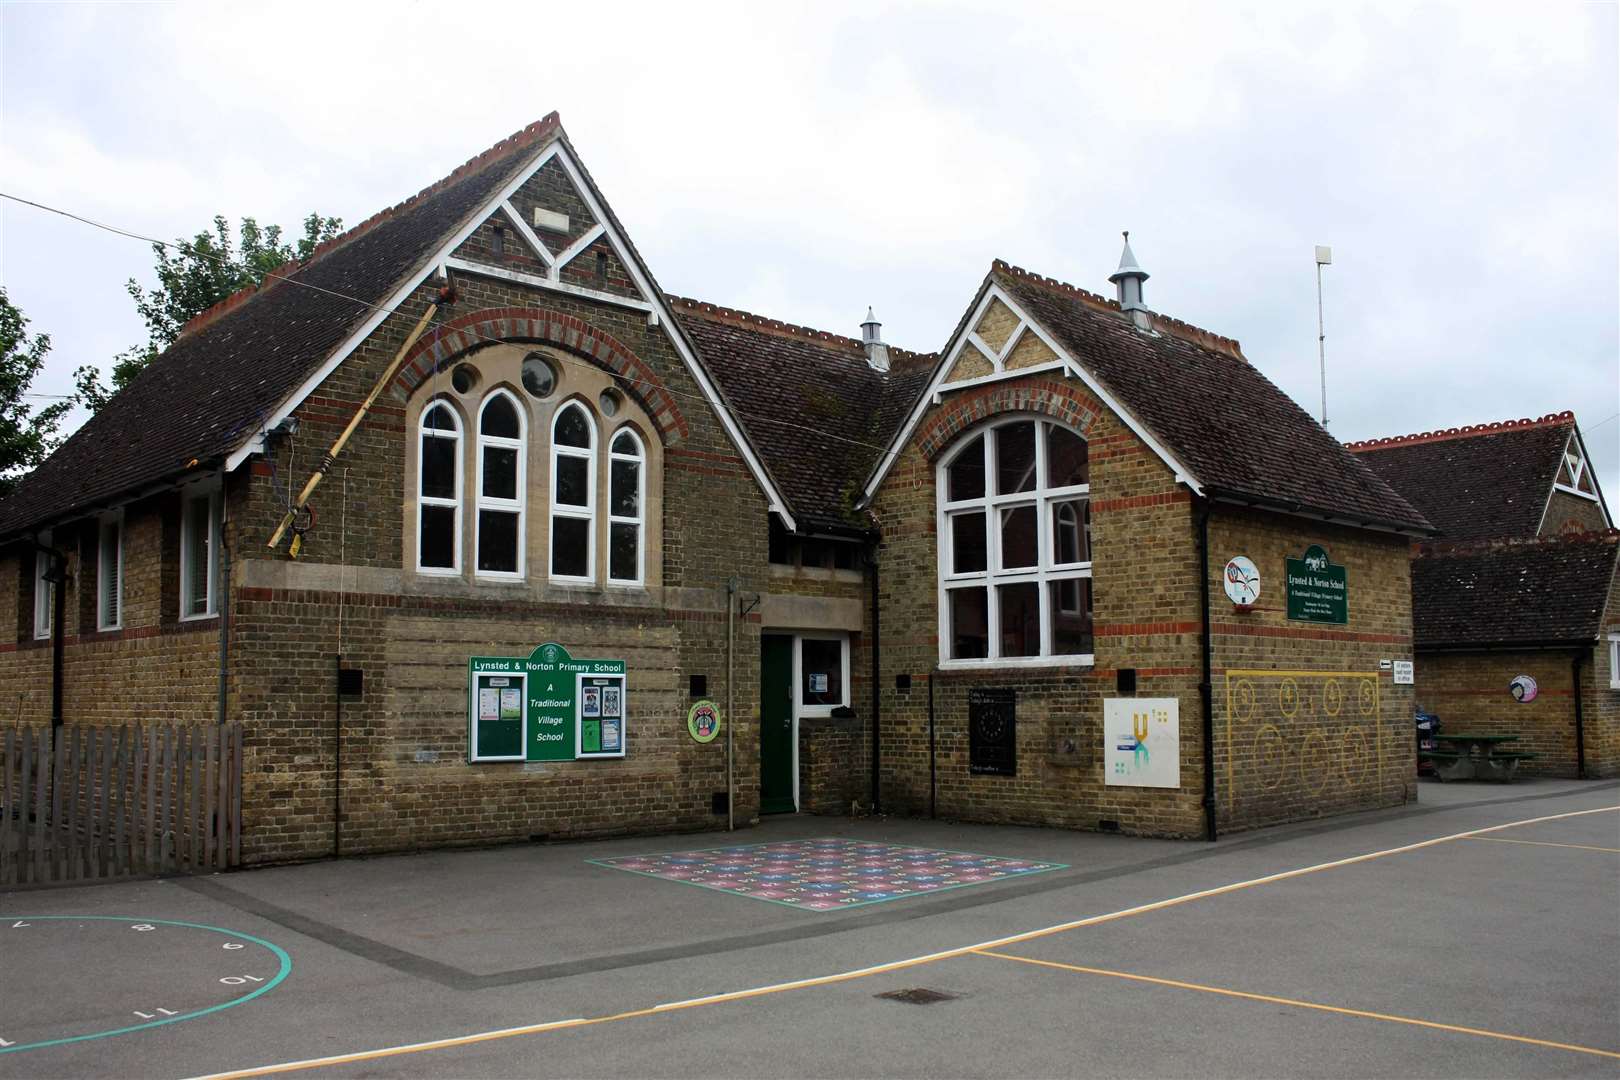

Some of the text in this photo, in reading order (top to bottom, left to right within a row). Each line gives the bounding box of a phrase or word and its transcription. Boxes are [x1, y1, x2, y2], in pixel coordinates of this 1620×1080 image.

[1314, 577, 1329, 588] Norton
[1330, 580, 1344, 590] School
[475, 662, 509, 671] Lynsted
[526, 662, 554, 670] Norton
[559, 664, 590, 672] Primary
[594, 664, 620, 672] School
[546, 684, 553, 692] A
[530, 700, 570, 708] Traditional
[538, 716, 563, 726] Village
[536, 733, 564, 742] School
[131, 924, 156, 932] 8
[219, 974, 264, 984] 10
[133, 1008, 179, 1018] 11
